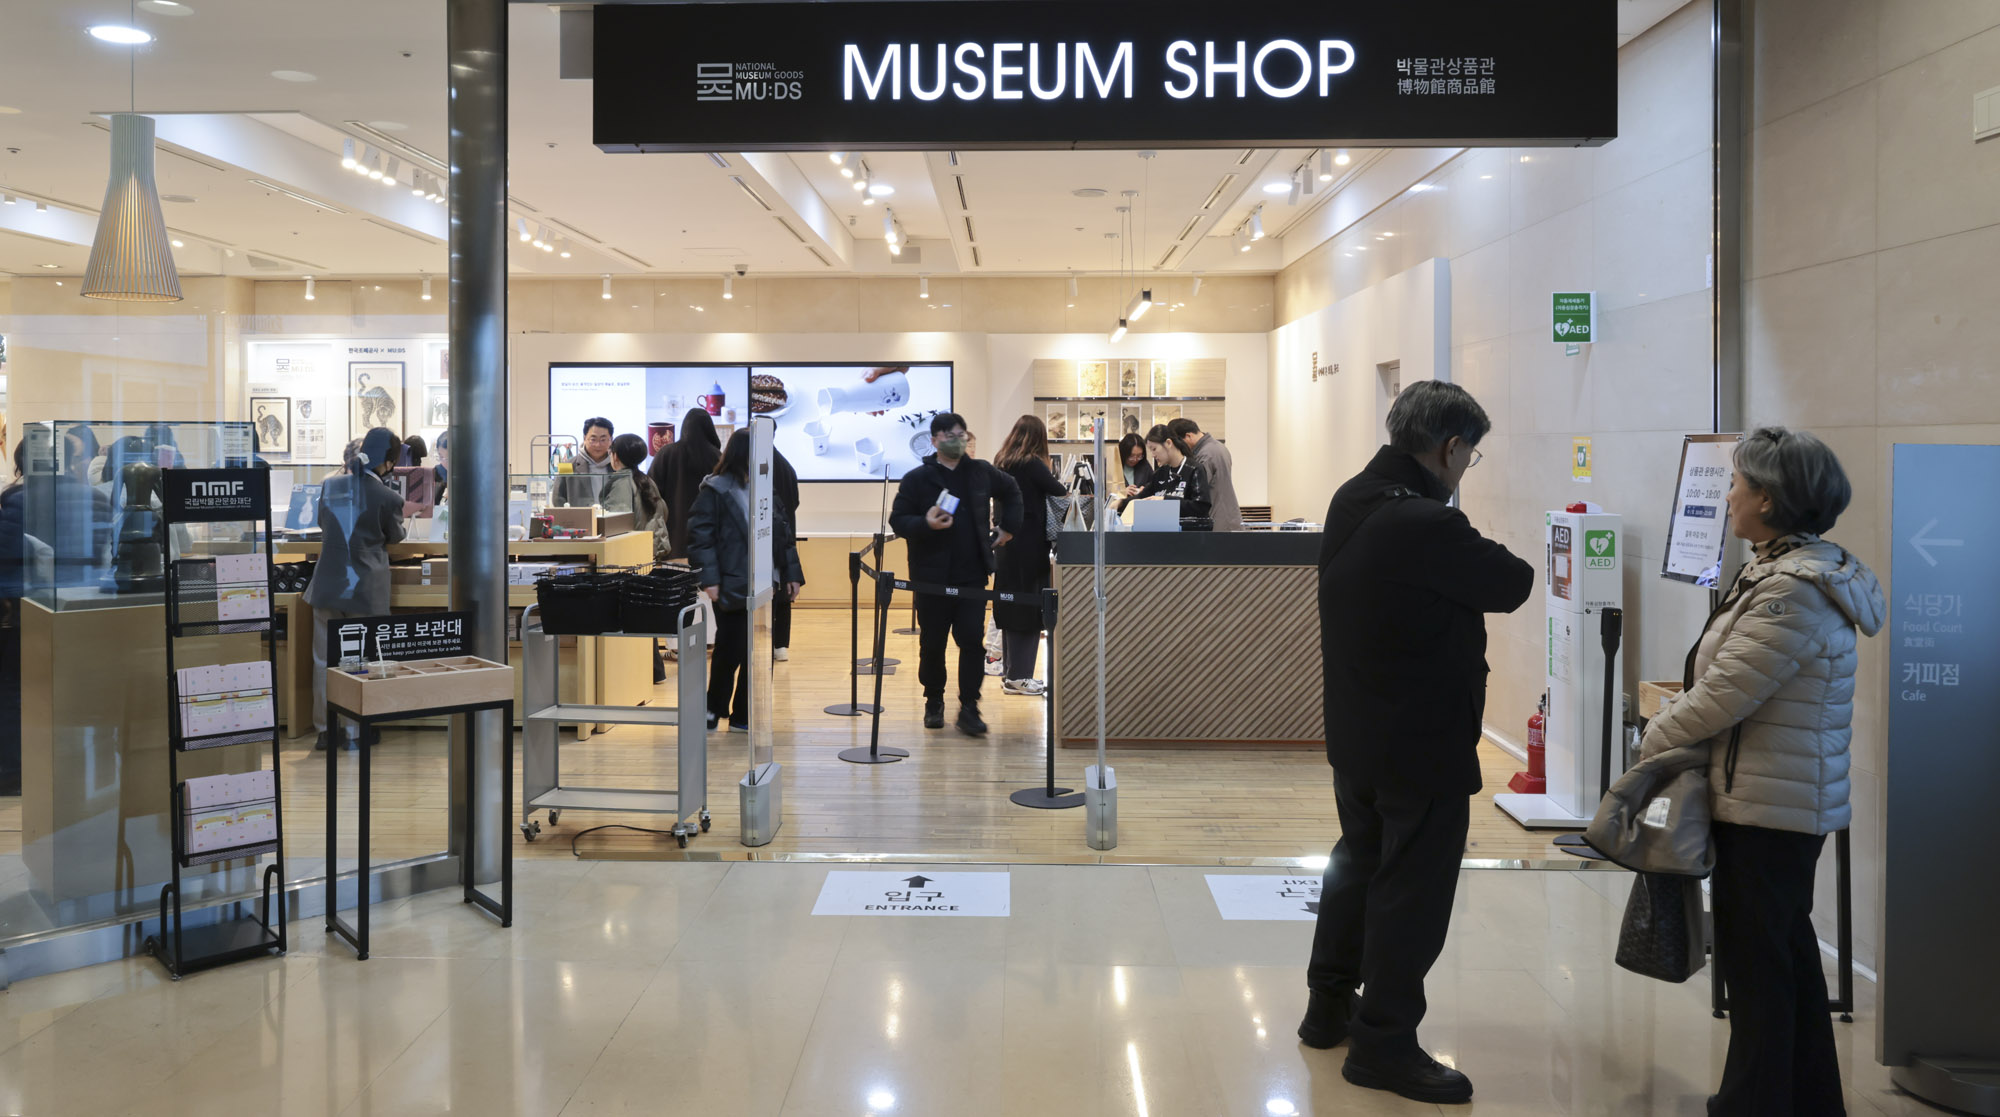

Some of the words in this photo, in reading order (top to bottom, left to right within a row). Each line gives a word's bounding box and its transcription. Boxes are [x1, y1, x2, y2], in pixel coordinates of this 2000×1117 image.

[735, 62, 777, 71] NATIONAL
[843, 41, 1133, 100] MUSEUM
[1164, 39, 1356, 99] SHOP
[1397, 57, 1496, 76] 박물관상품관
[735, 71, 772, 80] MUSEUM
[774, 71, 804, 79] GOODS
[735, 81, 802, 100] MU:DS
[1397, 78, 1496, 95] 博物館商品館
[1569, 325, 1590, 334] AED
[1689, 467, 1704, 477] 상품관
[1686, 489, 1700, 498] 10:00
[1705, 490, 1720, 499] 18:00
[185, 497, 252, 506] 국립박물관문화재단
[1554, 527, 1570, 544] AED
[1589, 558, 1611, 567] AED
[1903, 593, 1962, 617] 식당가
[375, 624, 408, 641] 음료
[414, 619, 461, 637] 보관대
[1903, 621, 1930, 633] Food
[1933, 621, 1962, 633] Court
[1902, 662, 1960, 686] 커피점
[1901, 690, 1927, 702] Cafe
[884, 891, 945, 902] 입구
